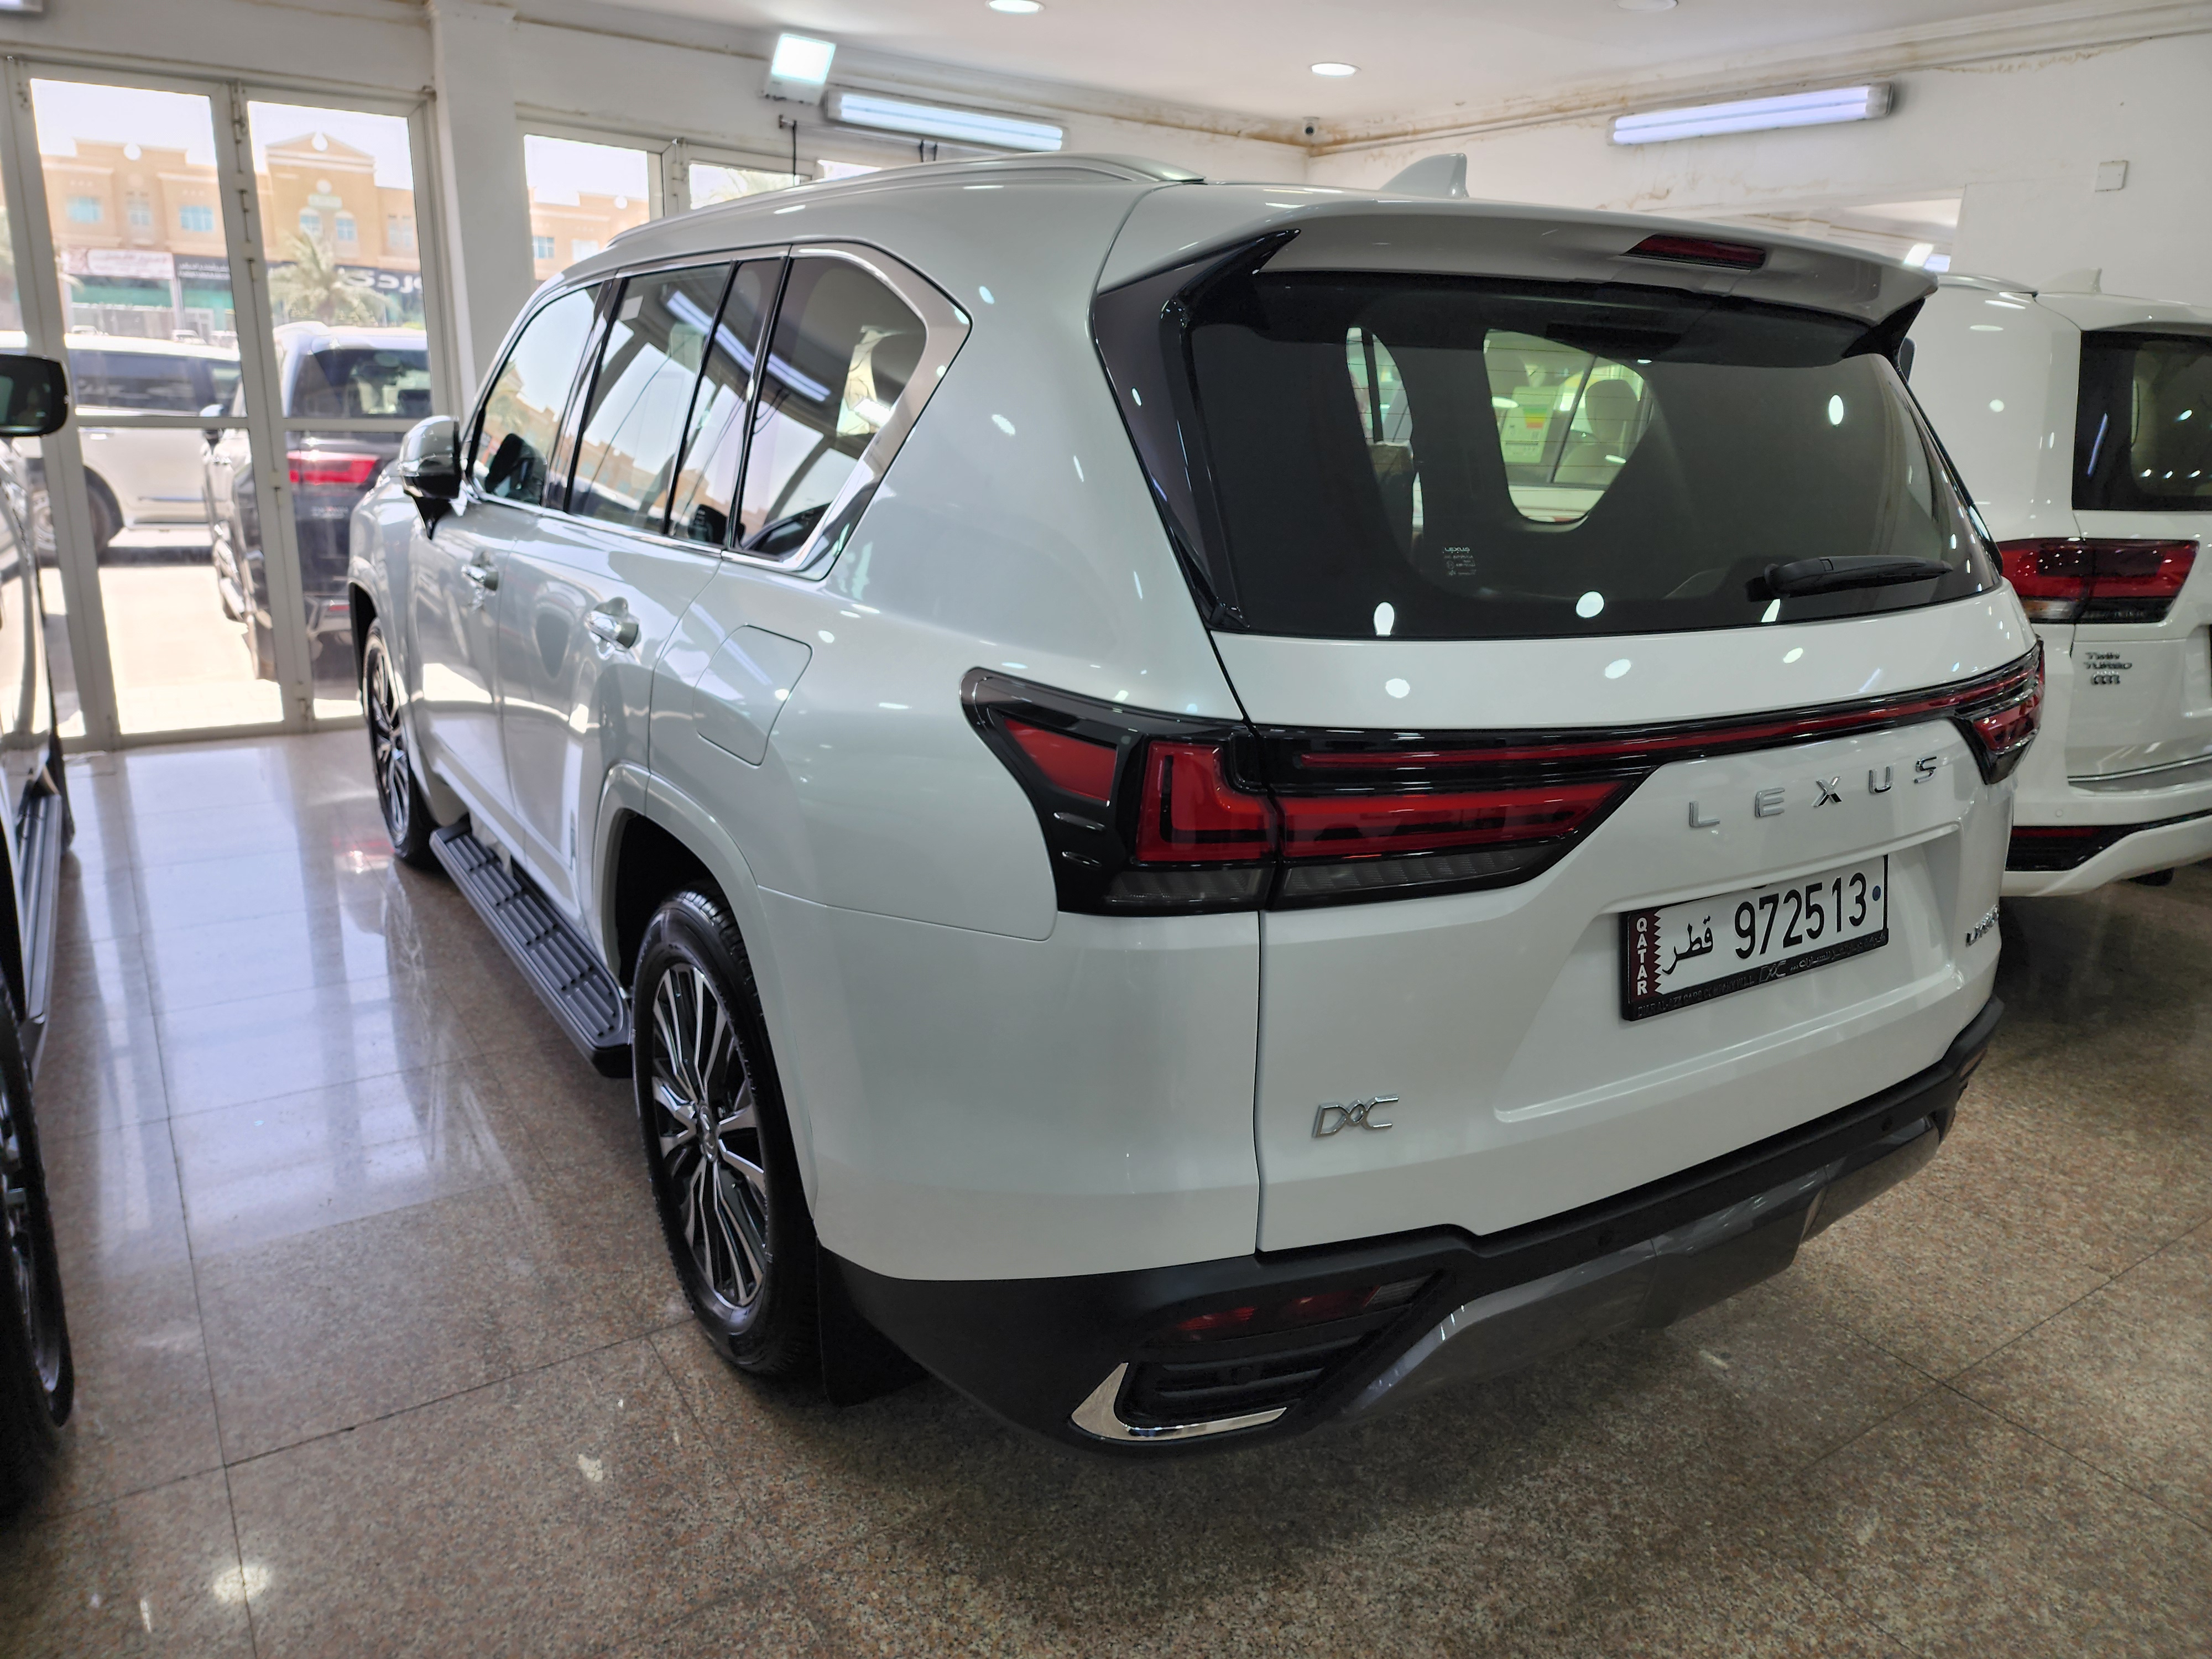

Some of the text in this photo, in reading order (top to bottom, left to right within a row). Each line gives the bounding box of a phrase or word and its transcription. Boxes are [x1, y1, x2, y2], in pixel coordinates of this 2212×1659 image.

[1689, 756, 1938, 828] LEXUS
[1661, 915, 1714, 975] قطر
[1733, 872, 1867, 959] 972513
[1636, 917, 1648, 997] QATAR
